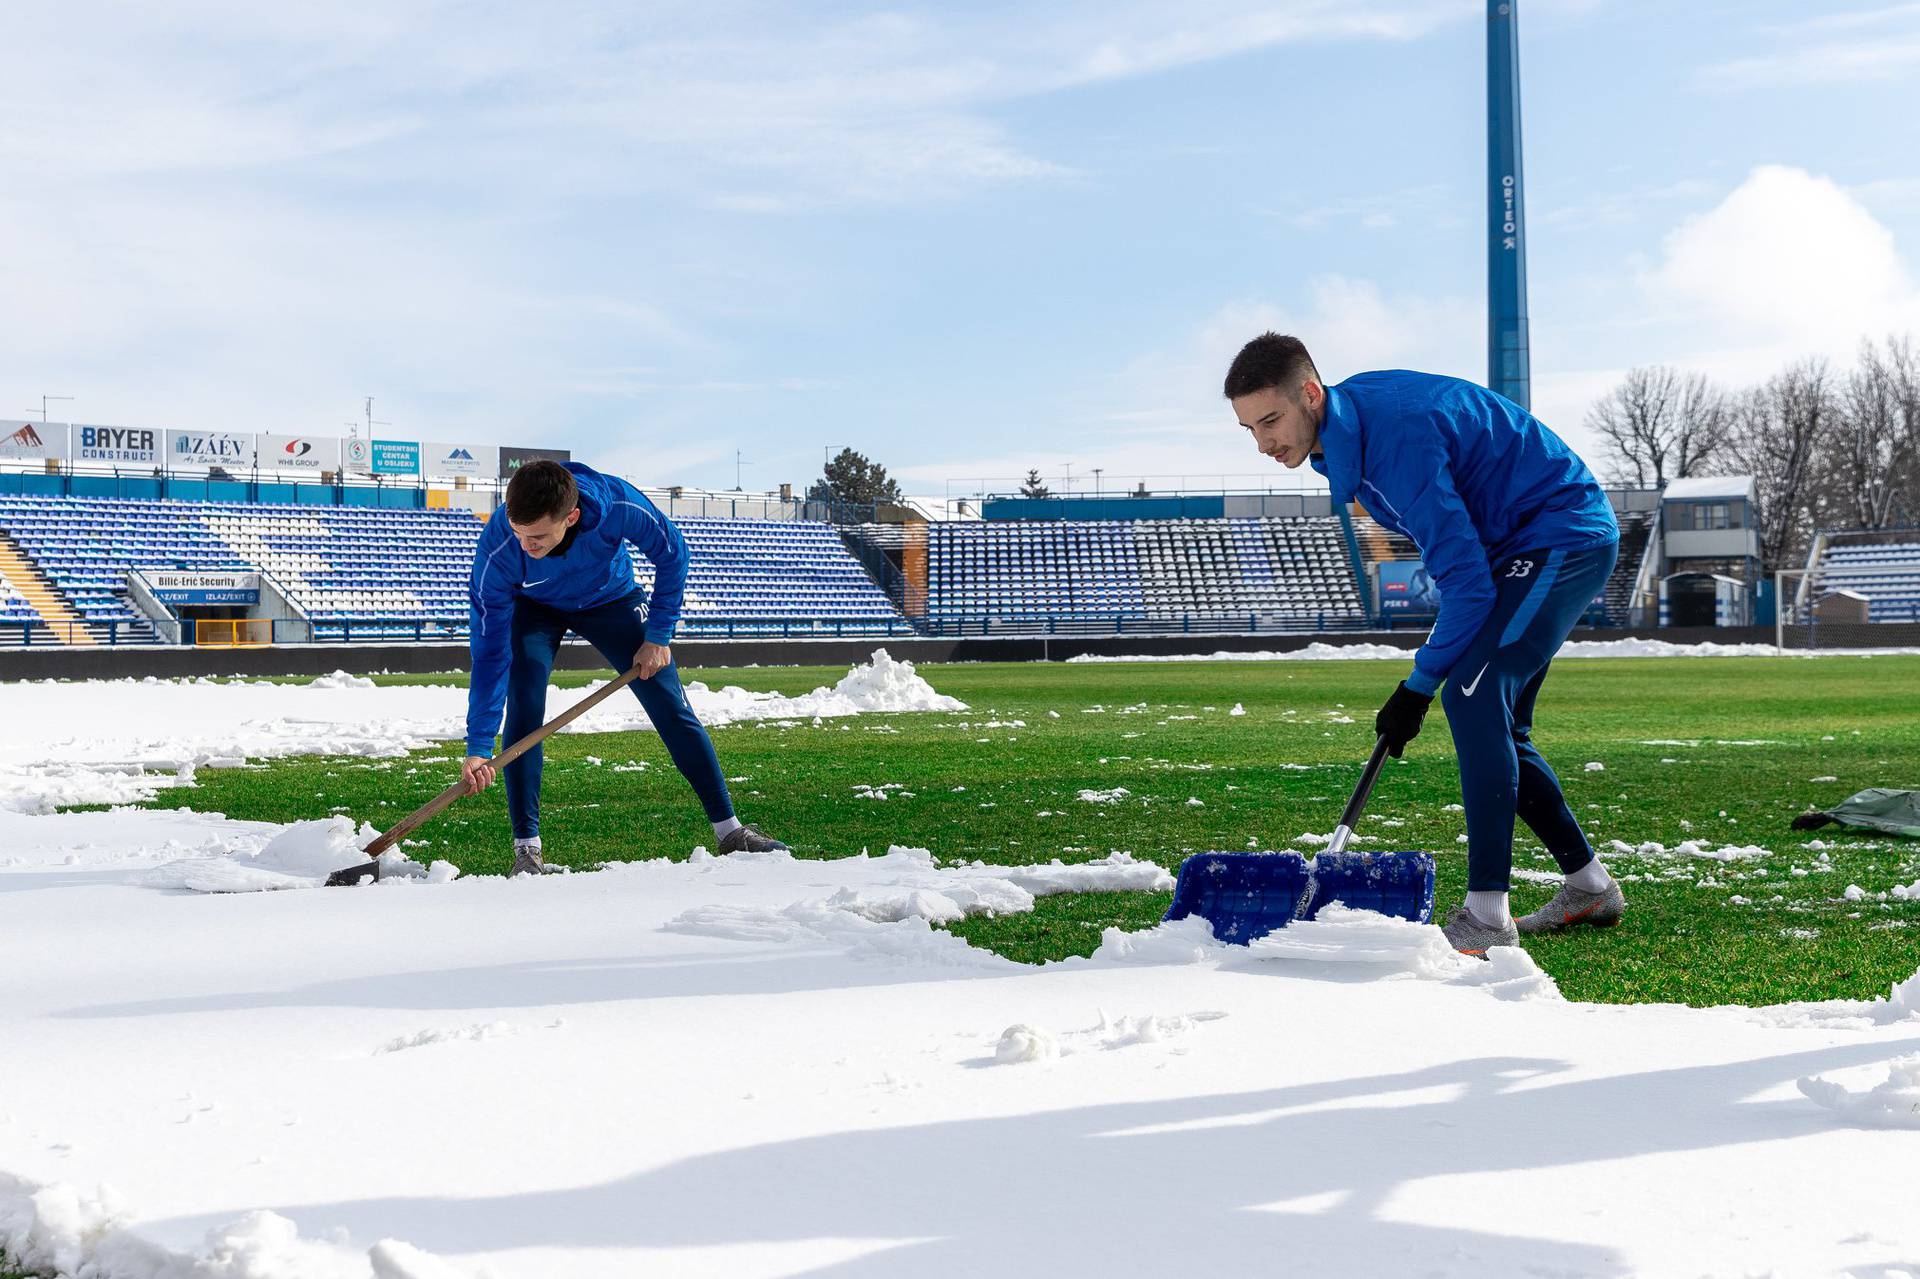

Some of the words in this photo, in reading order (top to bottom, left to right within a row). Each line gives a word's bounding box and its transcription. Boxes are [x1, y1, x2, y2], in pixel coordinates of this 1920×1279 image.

[81, 426, 154, 450] BAYER
[192, 433, 245, 456] ZÁÉV
[82, 449, 154, 461] CONSTRUCT
[373, 444, 418, 453] STUDENTSKI
[1505, 559, 1534, 578] 33
[200, 576, 236, 587] Security
[633, 602, 650, 623] 20
